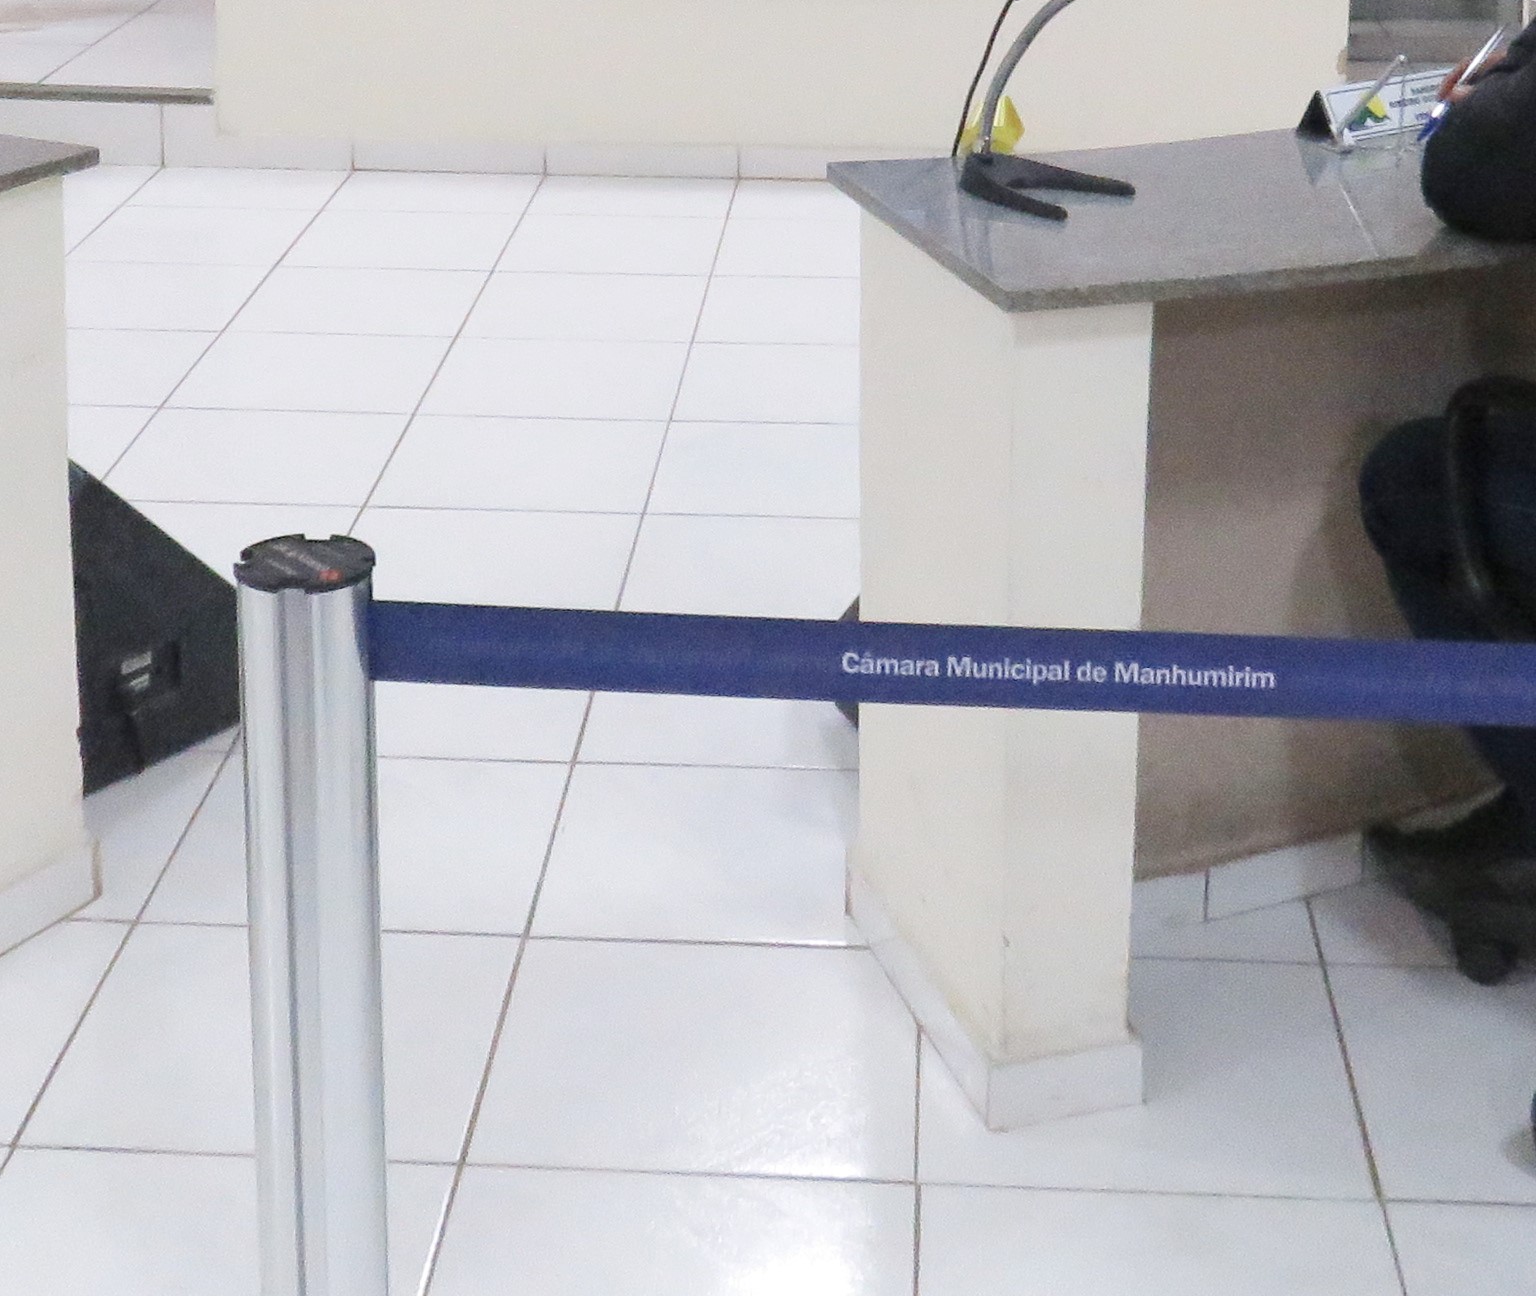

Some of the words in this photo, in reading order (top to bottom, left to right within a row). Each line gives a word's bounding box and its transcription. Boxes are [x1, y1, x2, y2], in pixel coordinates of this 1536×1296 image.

[842, 651, 940, 677] Câmara
[947, 656, 1070, 685] Municipal
[1076, 661, 1108, 683] de
[1114, 661, 1277, 689] Manhumirim
